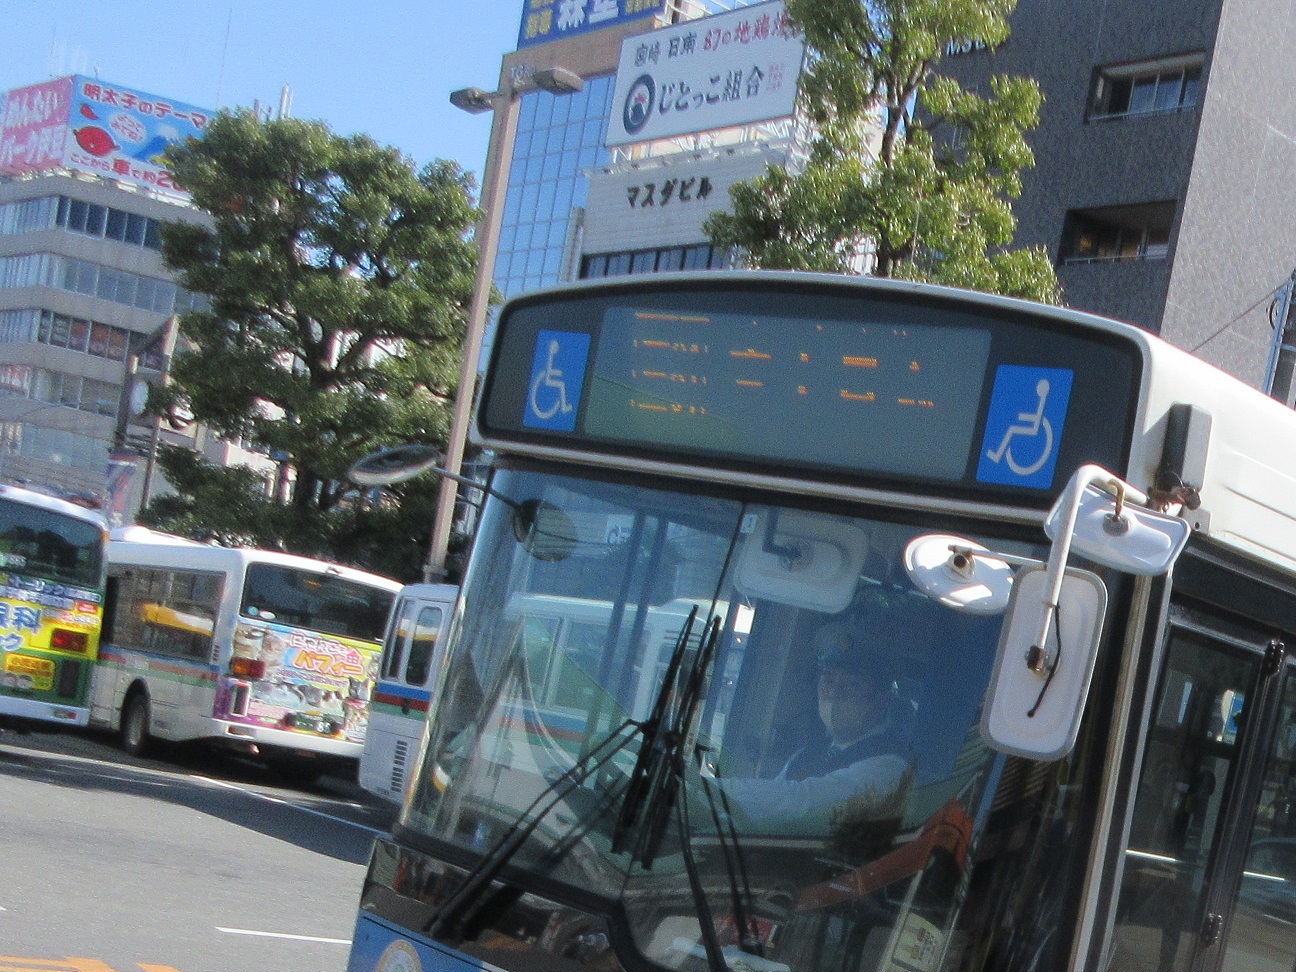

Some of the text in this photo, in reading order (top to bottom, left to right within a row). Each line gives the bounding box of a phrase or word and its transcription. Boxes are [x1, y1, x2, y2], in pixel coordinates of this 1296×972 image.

[626, 175, 714, 209] マスダビル
